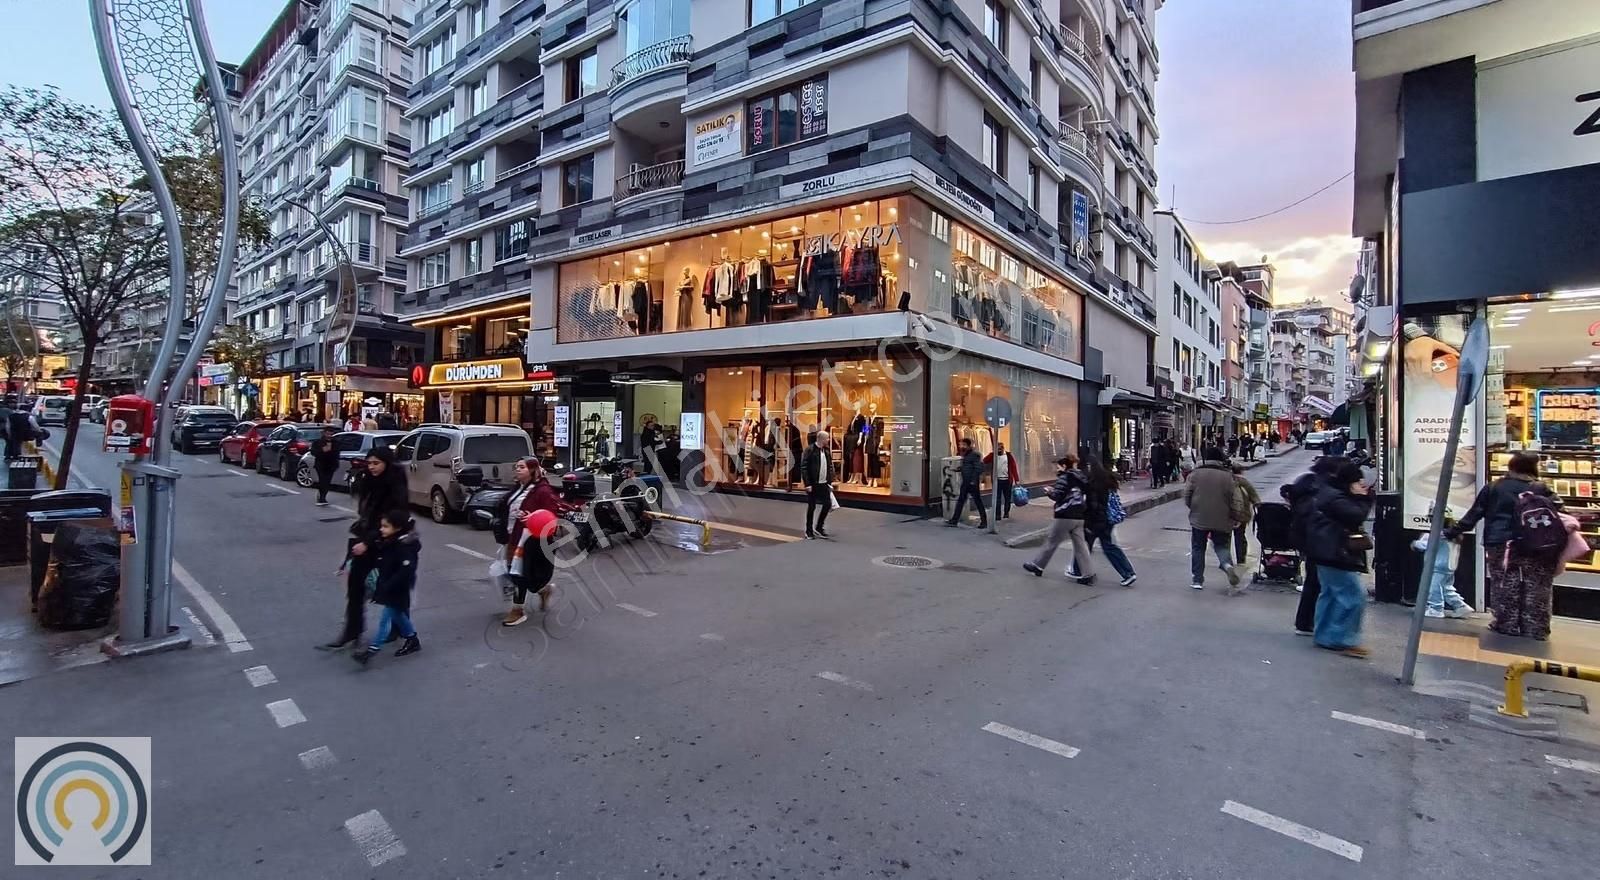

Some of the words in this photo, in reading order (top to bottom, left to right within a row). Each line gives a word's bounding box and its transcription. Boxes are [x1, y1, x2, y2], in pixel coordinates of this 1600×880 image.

[801, 80, 813, 125] estee
[813, 85, 824, 117] laser
[696, 116, 725, 135] SATILIK
[753, 106, 763, 145] ZORLU
[802, 175, 836, 193] ZORLU
[578, 234, 595, 244] ESTEE
[594, 229, 612, 240] LASER
[822, 223, 904, 254] KAYRA
[445, 363, 503, 382] DÜRÜMDEN
[1415, 417, 1468, 425] ARADIN
